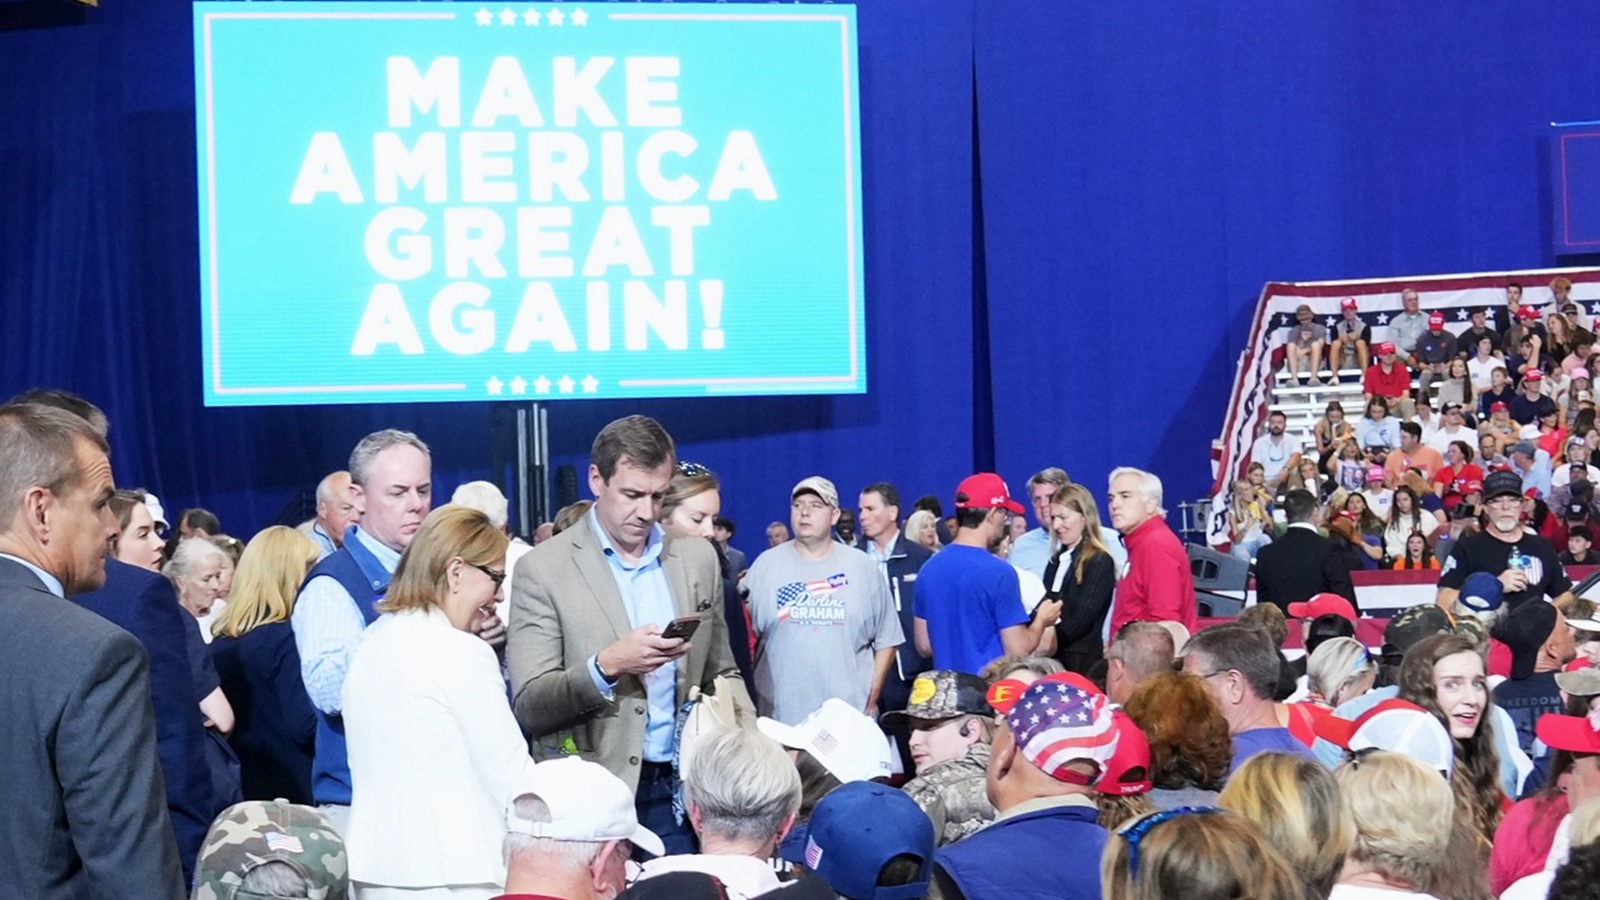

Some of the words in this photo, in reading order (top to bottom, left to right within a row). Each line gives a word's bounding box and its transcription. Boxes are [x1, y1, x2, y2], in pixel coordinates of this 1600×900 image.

[387, 56, 682, 129] MAKE
[290, 130, 778, 204] AMERICA
[364, 205, 711, 280] GREAT
[351, 279, 726, 355] AGAIN!
[790, 606, 845, 620] GRAHAM
